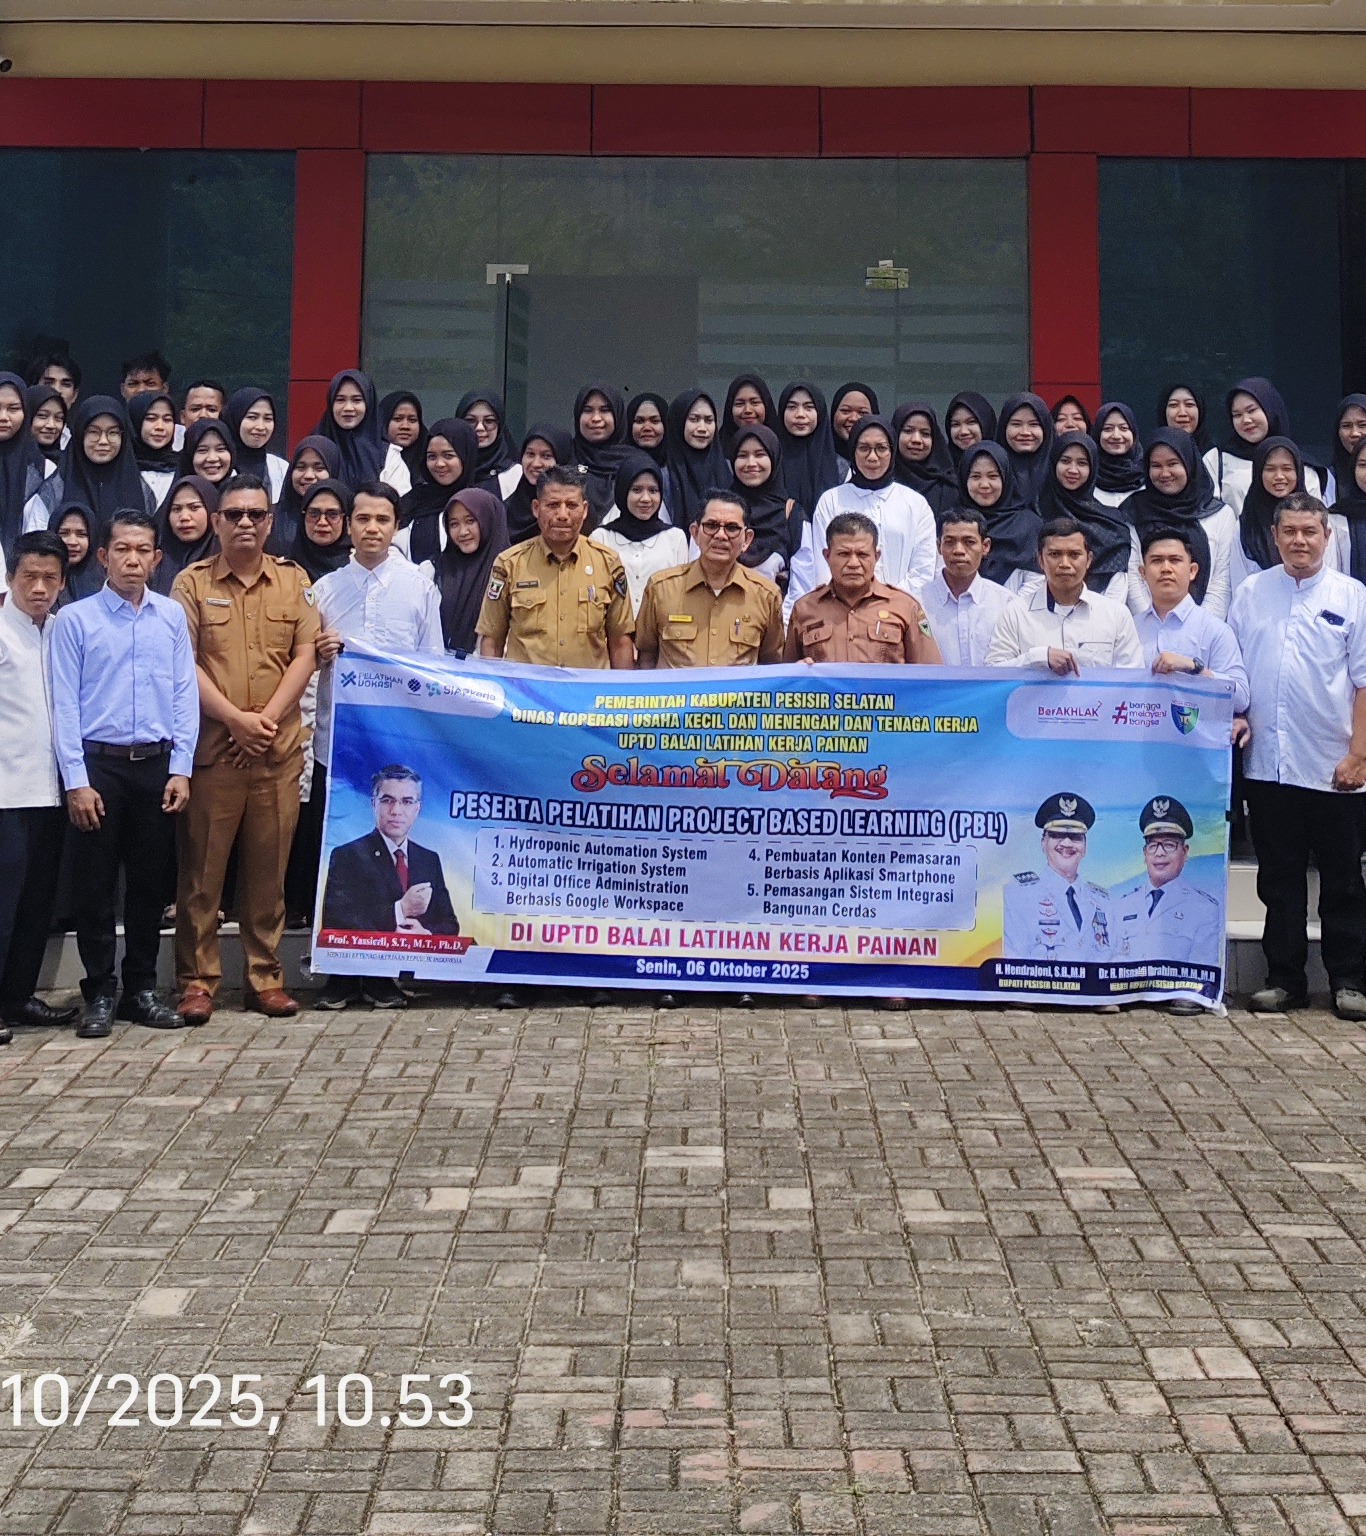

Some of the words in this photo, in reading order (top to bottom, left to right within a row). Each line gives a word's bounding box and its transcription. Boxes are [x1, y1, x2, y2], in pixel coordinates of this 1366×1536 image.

[358, 672, 403, 685] PELATIHAN
[358, 680, 392, 688] VOKASI
[595, 695, 685, 709] PEMERINTAH
[690, 692, 771, 708] KABUPATEN
[775, 693, 830, 708] PESISIR
[834, 694, 894, 710] SELATAN
[1038, 707, 1098, 716] BerAKHLAK
[512, 709, 554, 724] DINAS
[558, 712, 628, 727] KOPERASI
[632, 714, 680, 728] USAHA
[684, 714, 724, 728] KECIL
[728, 714, 756, 729] DAN
[761, 714, 839, 730] MENENGAH
[843, 715, 872, 731] DAN
[876, 716, 930, 732] TENAGA
[934, 717, 978, 732] KERJA
[618, 733, 655, 749] UPTD
[660, 734, 701, 750] BALAI
[705, 735, 763, 751] LATIHAN
[768, 736, 812, 751] KERJA
[816, 737, 868, 752] PAINAN
[571, 755, 741, 792] Selamat
[735, 757, 888, 799] Datang
[450, 791, 543, 823] PESERTA
[546, 799, 663, 833] PELATIHAN
[666, 806, 764, 835] PROJECT
[767, 808, 838, 835] BASED
[840, 809, 945, 837] LEARNING
[949, 811, 1008, 844] (PBL)
[493, 835, 504, 848] 1.
[510, 835, 580, 856] Hydroponic
[585, 842, 657, 859] Automation
[662, 846, 707, 864] System
[749, 848, 761, 861] 4.
[765, 848, 837, 863] Pembuatan
[841, 850, 886, 864] Konten
[890, 852, 961, 866] Pemasaran
[492, 854, 503, 867] 2.
[508, 854, 573, 870] Automatic
[578, 858, 636, 876] Irrigation
[641, 864, 687, 880] System
[765, 866, 819, 880] Berbasis
[823, 868, 874, 885] Aplikasi
[878, 869, 956, 887] Smartphone
[491, 873, 503, 886] 3.
[507, 873, 549, 890] Digital
[553, 875, 591, 890] Office
[595, 880, 689, 895] Administration
[747, 883, 759, 896] 5.
[763, 884, 845, 901] Pemasangan
[849, 886, 892, 900] Sistem
[897, 888, 954, 905] Integrasi
[506, 892, 562, 907] Berbasis
[566, 895, 609, 914] Google
[614, 895, 684, 913] Workspace
[763, 901, 827, 917] Bangunan
[832, 903, 877, 918] Cerdas
[328, 934, 349, 945] Prof.
[510, 922, 533, 942] DI
[541, 923, 599, 945] UPTD
[607, 925, 671, 947] BALAI
[679, 929, 771, 951] LATIHAN
[779, 931, 850, 953] KERJA
[857, 934, 937, 956] PAINAN
[636, 958, 682, 976] Senin,
[687, 961, 705, 976] 06
[710, 962, 768, 978] Oktober
[772, 964, 810, 979] 2025
